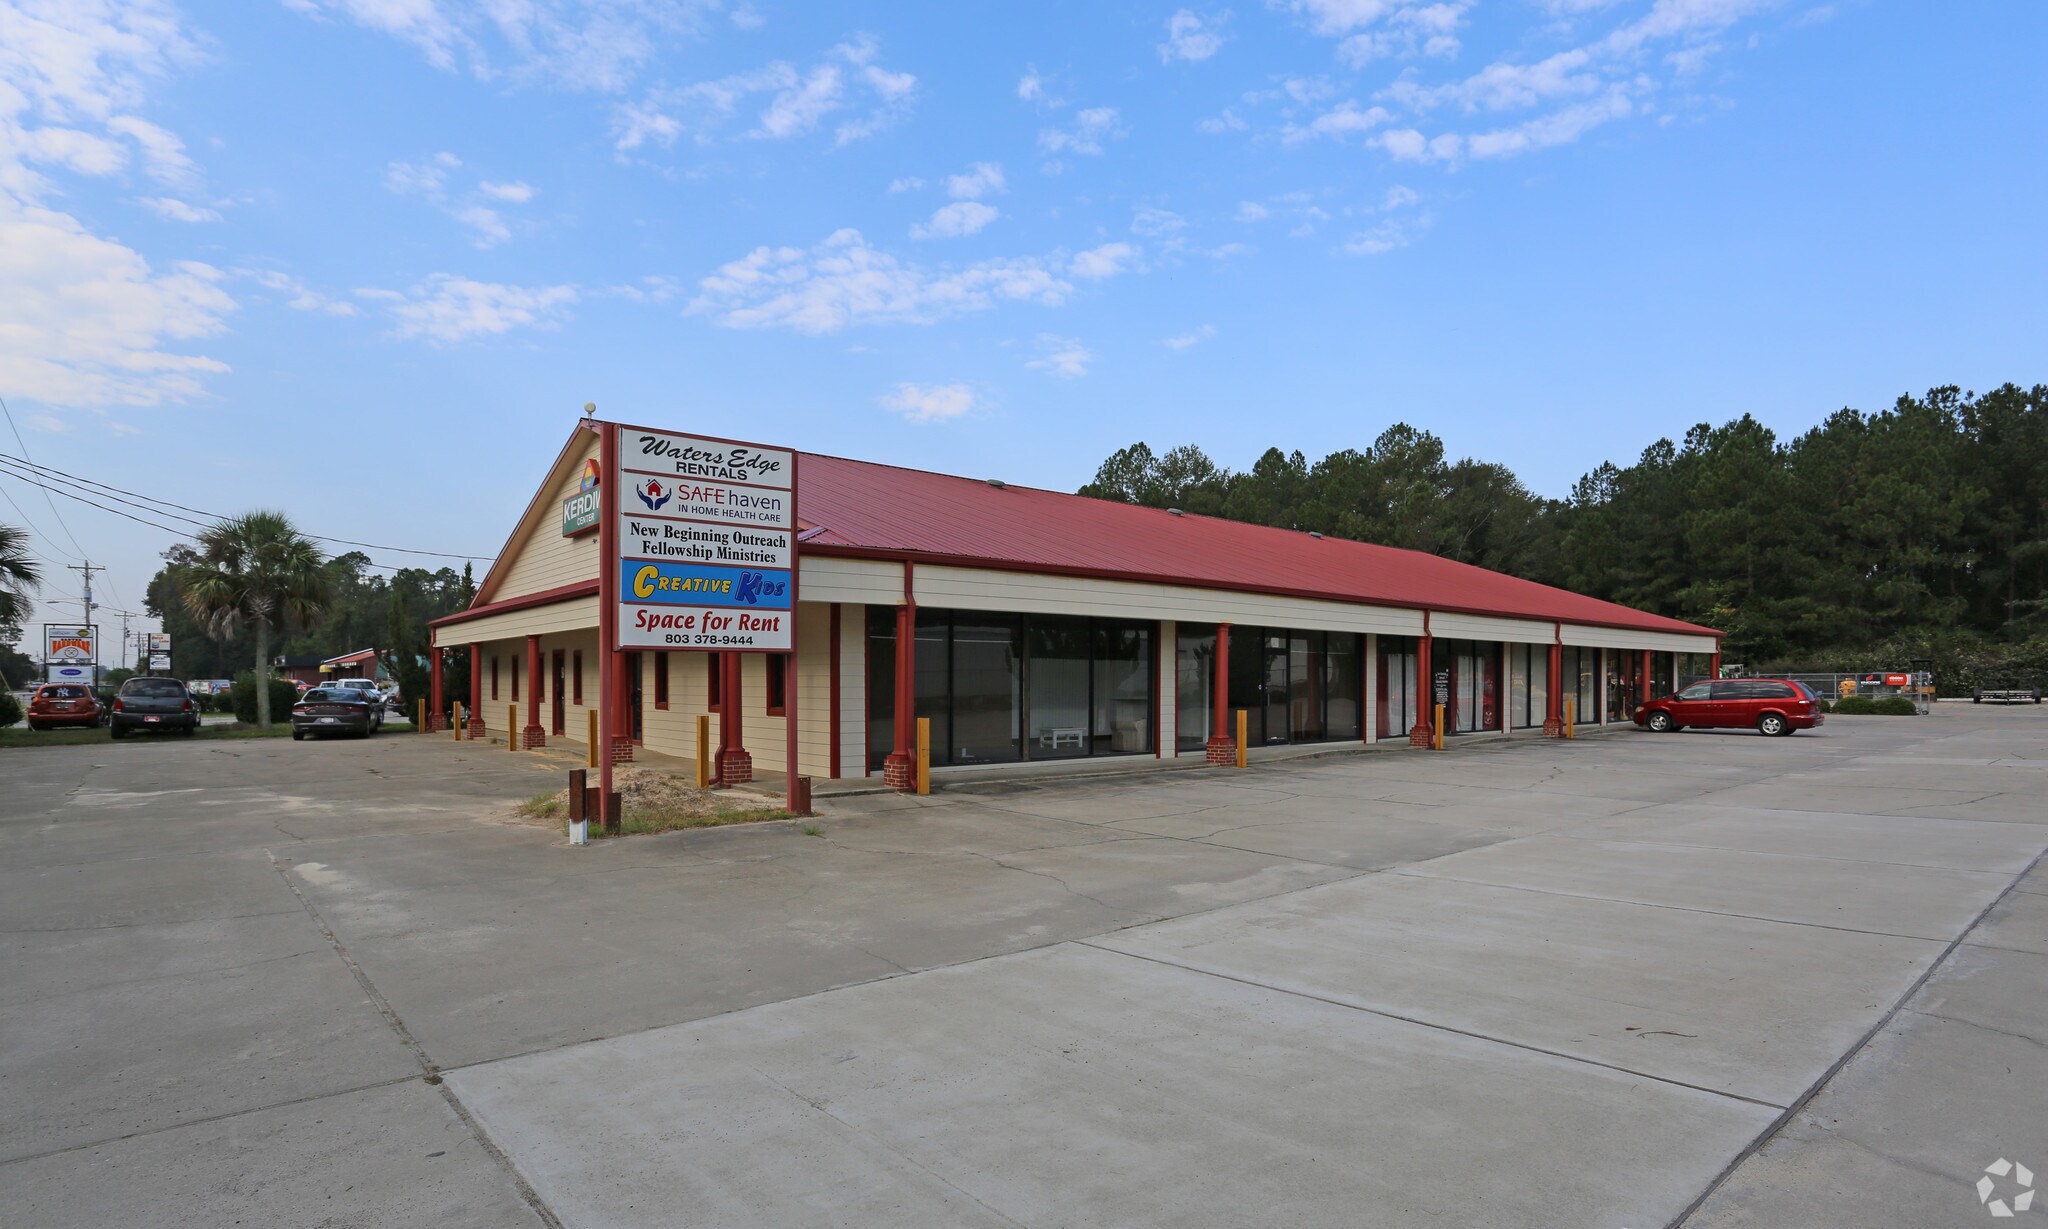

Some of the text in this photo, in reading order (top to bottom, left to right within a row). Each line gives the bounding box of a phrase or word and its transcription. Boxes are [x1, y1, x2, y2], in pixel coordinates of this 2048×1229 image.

[639, 436, 781, 475] Waters Edge
[676, 461, 748, 481] RENTALS
[678, 484, 781, 511] SAFE haven
[577, 513, 595, 526] CENTER
[678, 504, 781, 523] IN HOME HEALTH CARE
[630, 522, 786, 548] New Beginning Outreach
[642, 540, 776, 563] Fellowship Ministries
[633, 565, 786, 604] CREATIVE KIDS
[635, 609, 780, 634] Space for Rent
[665, 633, 754, 645] 803 378-9444
